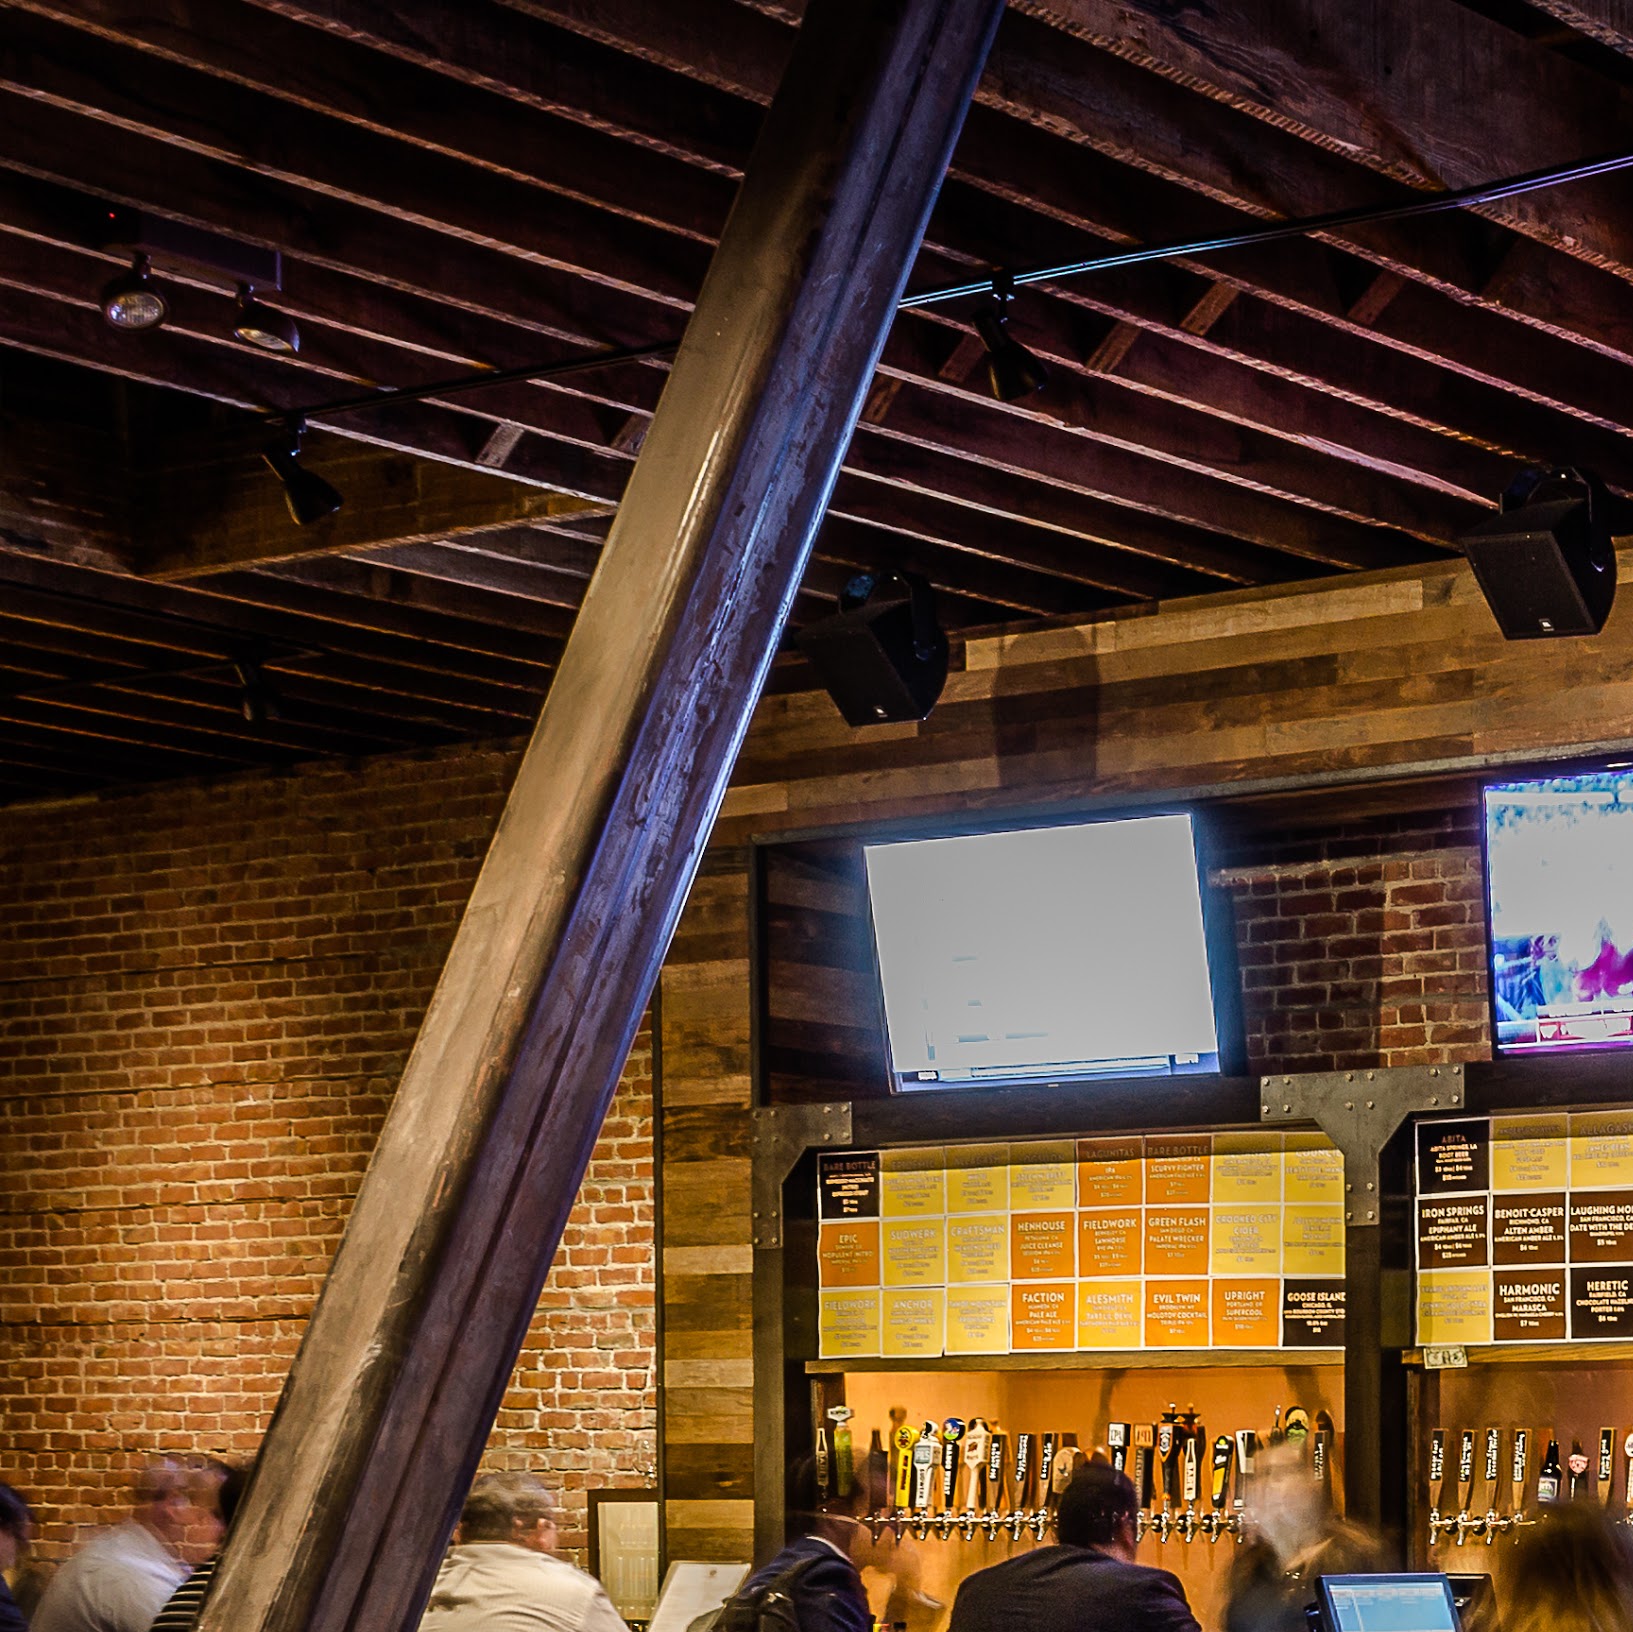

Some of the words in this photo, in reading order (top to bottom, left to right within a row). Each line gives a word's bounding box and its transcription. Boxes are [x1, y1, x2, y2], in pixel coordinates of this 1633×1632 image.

[1442, 1134, 1467, 1143] ABITA
[1147, 1147, 1171, 1157] BARE
[1173, 1145, 1209, 1155] BOTTLE
[1422, 1207, 1445, 1218] IRON
[1446, 1205, 1485, 1217] SPRINGS
[1570, 1205, 1615, 1216] LAUGHING
[1018, 1221, 1065, 1231] HENHOUSE
[1084, 1219, 1137, 1230] FIELDWORK
[1148, 1217, 1174, 1228] GREEN
[1176, 1217, 1206, 1227] FLASH
[1570, 1224, 1587, 1232] DATE
[1587, 1223, 1608, 1231] WITH
[1609, 1223, 1623, 1231] THE
[951, 1225, 1005, 1236] CRAFTSMAN
[1233, 1226, 1259, 1235] CIDER
[1428, 1225, 1463, 1234] EPIPHANY
[1463, 1224, 1477, 1233] ALE
[1504, 1227, 1526, 1236] ALTEN
[1528, 1226, 1554, 1234] AMBER
[839, 1234, 858, 1244] EPIC
[891, 1229, 936, 1240] SUDWERK
[1149, 1235, 1171, 1243] PALATE
[1172, 1234, 1205, 1242] WRECKER
[1499, 1283, 1560, 1296] HARMONIC
[1587, 1280, 1629, 1292] HERETIC
[1022, 1293, 1065, 1303] FACTION
[1086, 1294, 1134, 1304] ALESMITH
[1153, 1293, 1174, 1304] EVIL
[1175, 1293, 1201, 1303] TWIN
[1224, 1291, 1265, 1301] UPRIGHT
[1287, 1292, 1315, 1302] GOOSE
[824, 1300, 876, 1311] FIELDWORK
[893, 1300, 932, 1310] ANCHOR
[1512, 1304, 1547, 1312] MARASCA
[1177, 1311, 1207, 1319] COCKTAIL
